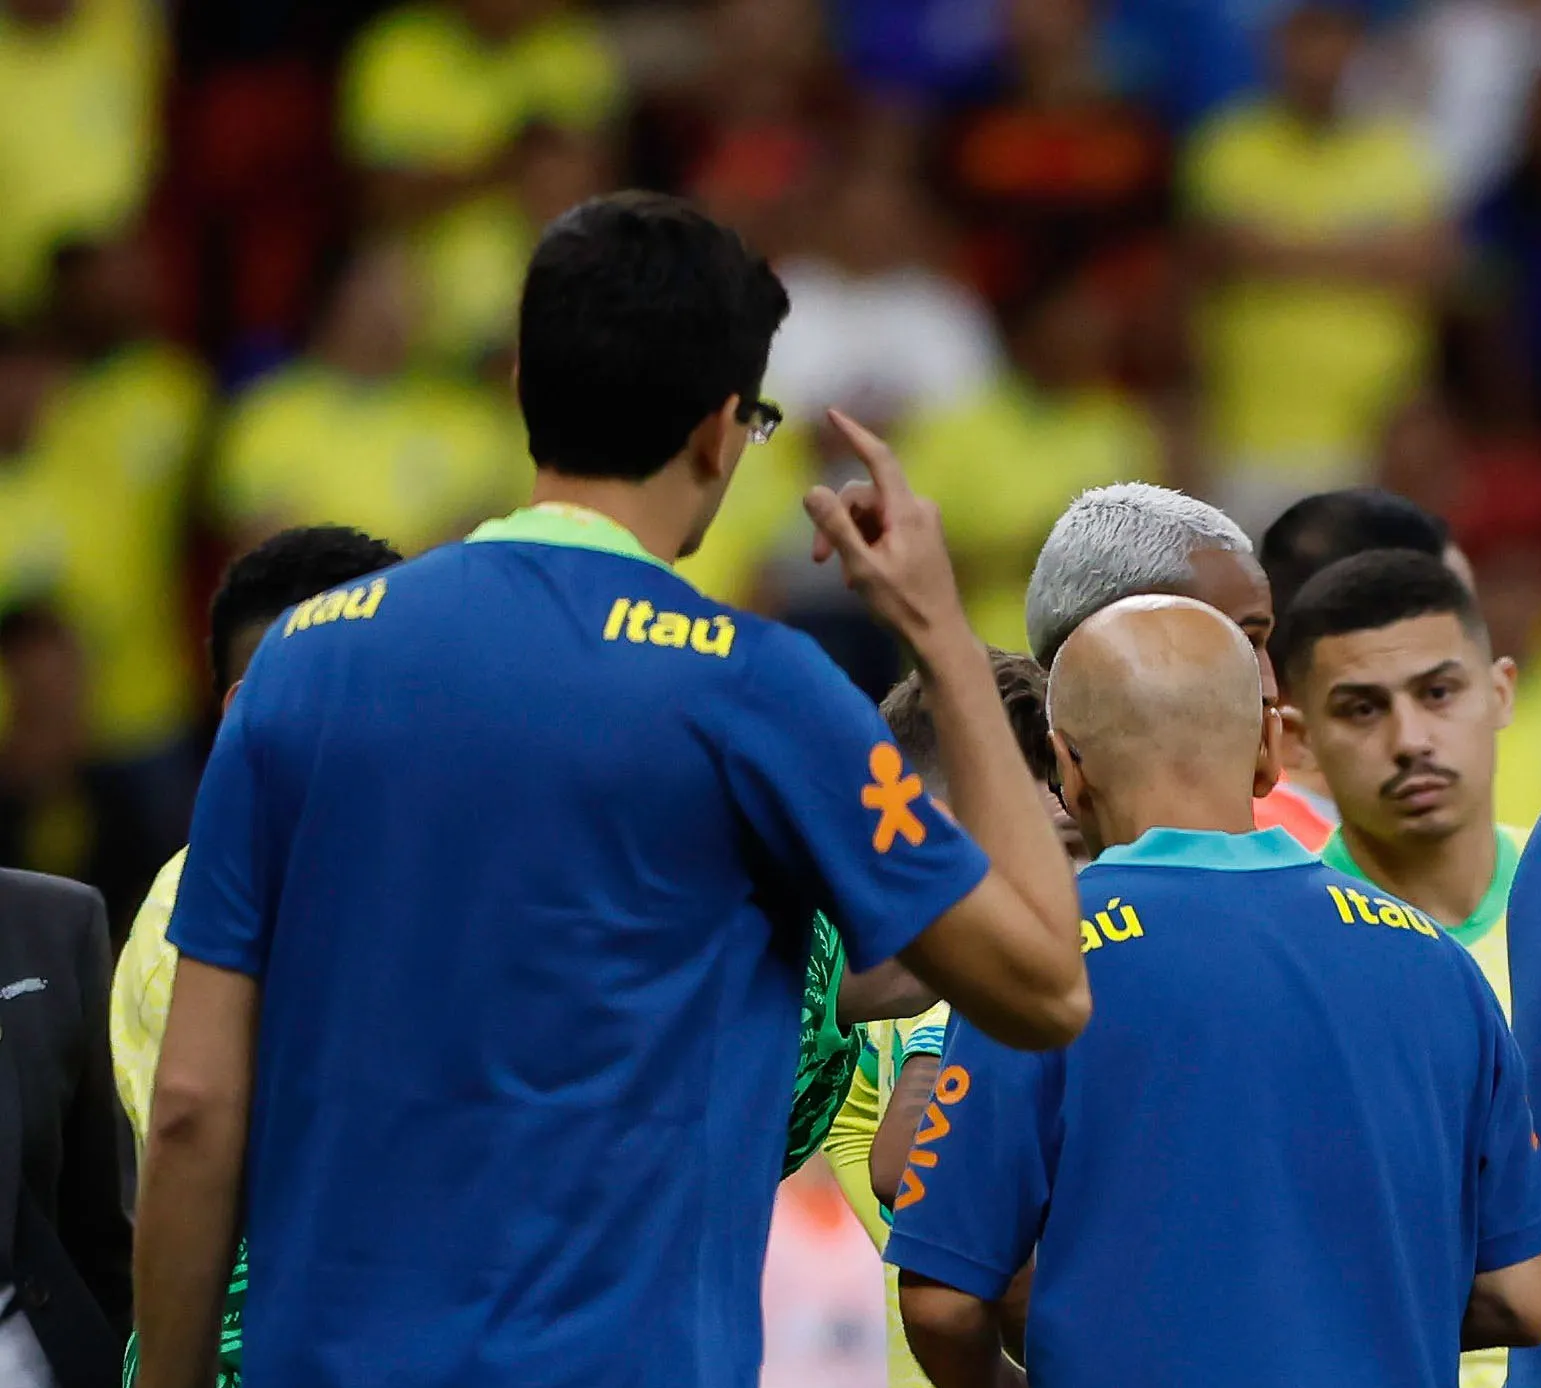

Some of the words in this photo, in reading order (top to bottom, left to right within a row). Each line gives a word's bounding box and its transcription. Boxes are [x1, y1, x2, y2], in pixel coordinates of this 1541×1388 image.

[602, 597, 736, 659] Itaú
[1080, 897, 1144, 954] aú
[894, 1064, 972, 1211] vivo
